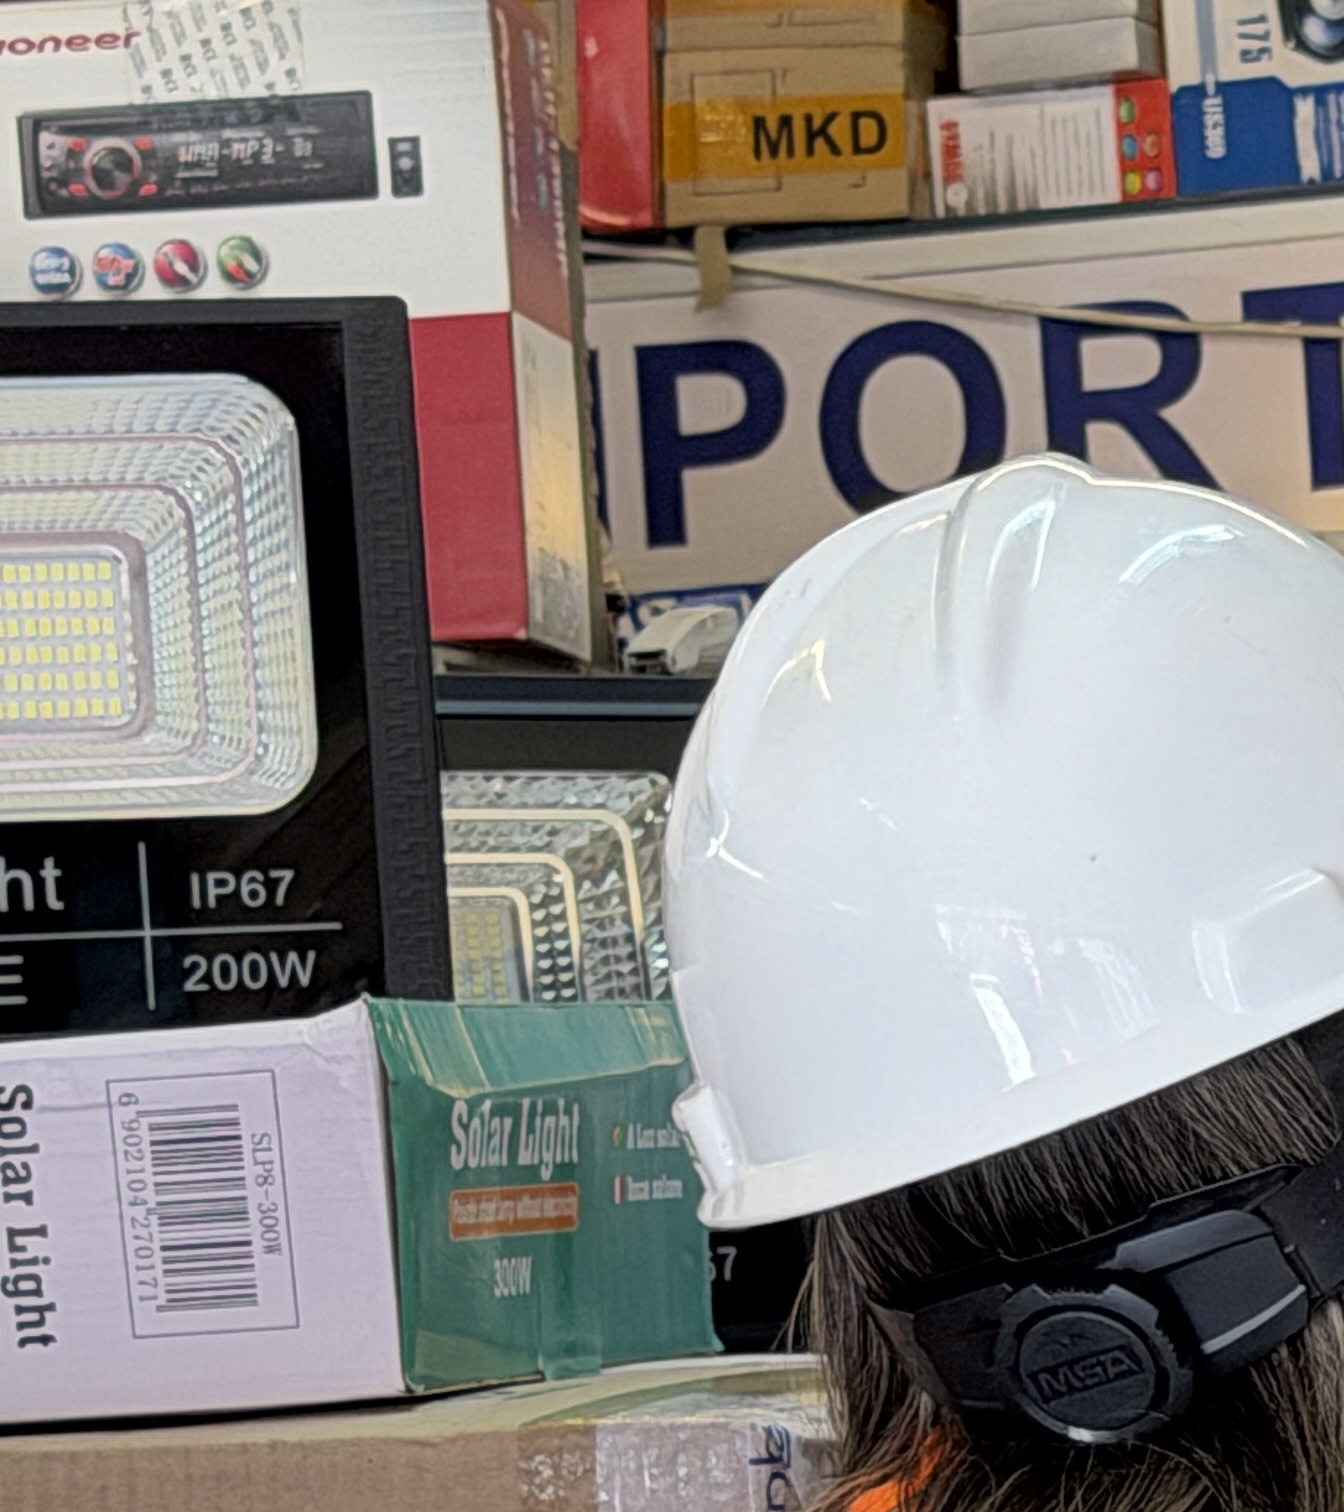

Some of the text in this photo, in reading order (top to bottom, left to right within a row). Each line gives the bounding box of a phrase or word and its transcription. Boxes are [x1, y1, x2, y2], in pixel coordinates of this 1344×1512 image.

[0, 31, 141, 56] oneer
[752, 110, 888, 162] MKD
[190, 868, 296, 910] IP67
[183, 950, 317, 992] 200W
[117, 1091, 140, 1108] 6
[450, 1096, 580, 1182] Solar Light
[0, 1082, 58, 1350] Solar Light
[249, 1130, 283, 1258] SLP8-300W
[493, 1255, 534, 1298] 300W
[1037, 1349, 1138, 1402] MSA
